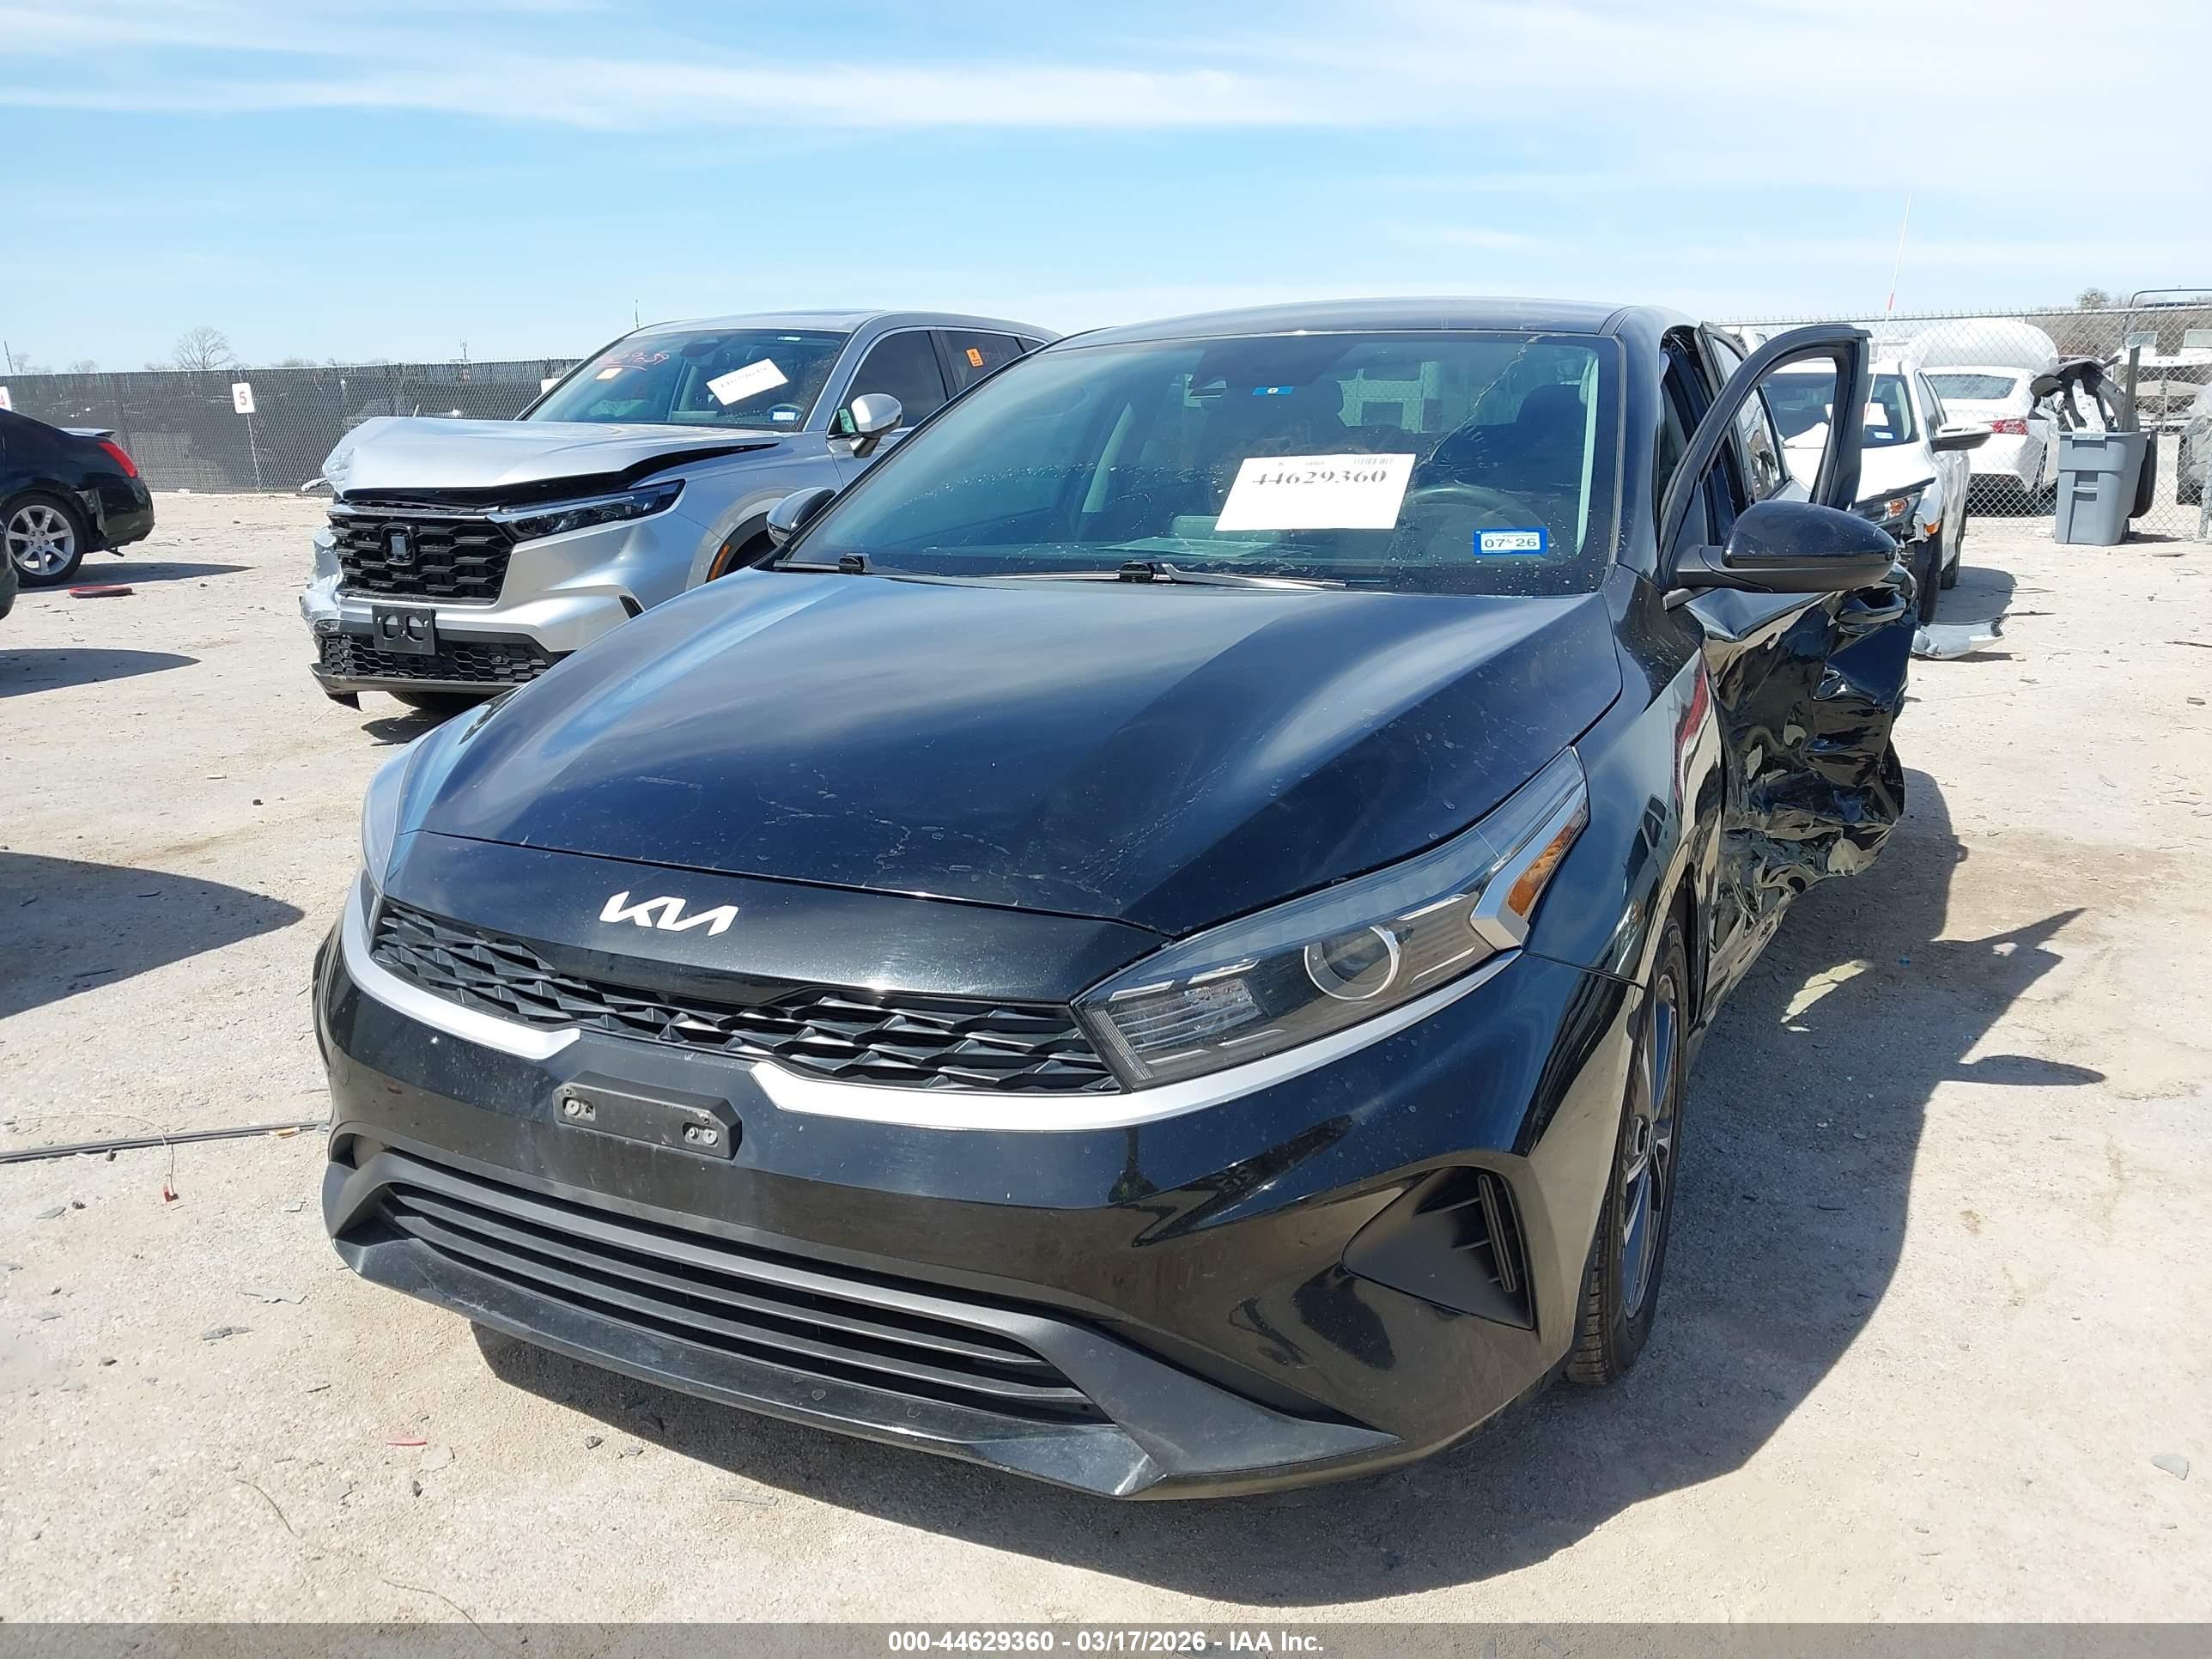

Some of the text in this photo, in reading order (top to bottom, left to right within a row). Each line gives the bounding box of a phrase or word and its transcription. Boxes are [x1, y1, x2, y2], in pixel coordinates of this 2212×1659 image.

[239, 391, 247, 405] 5
[1252, 469, 1387, 485] 44629360
[1484, 538, 1537, 548] 07 26
